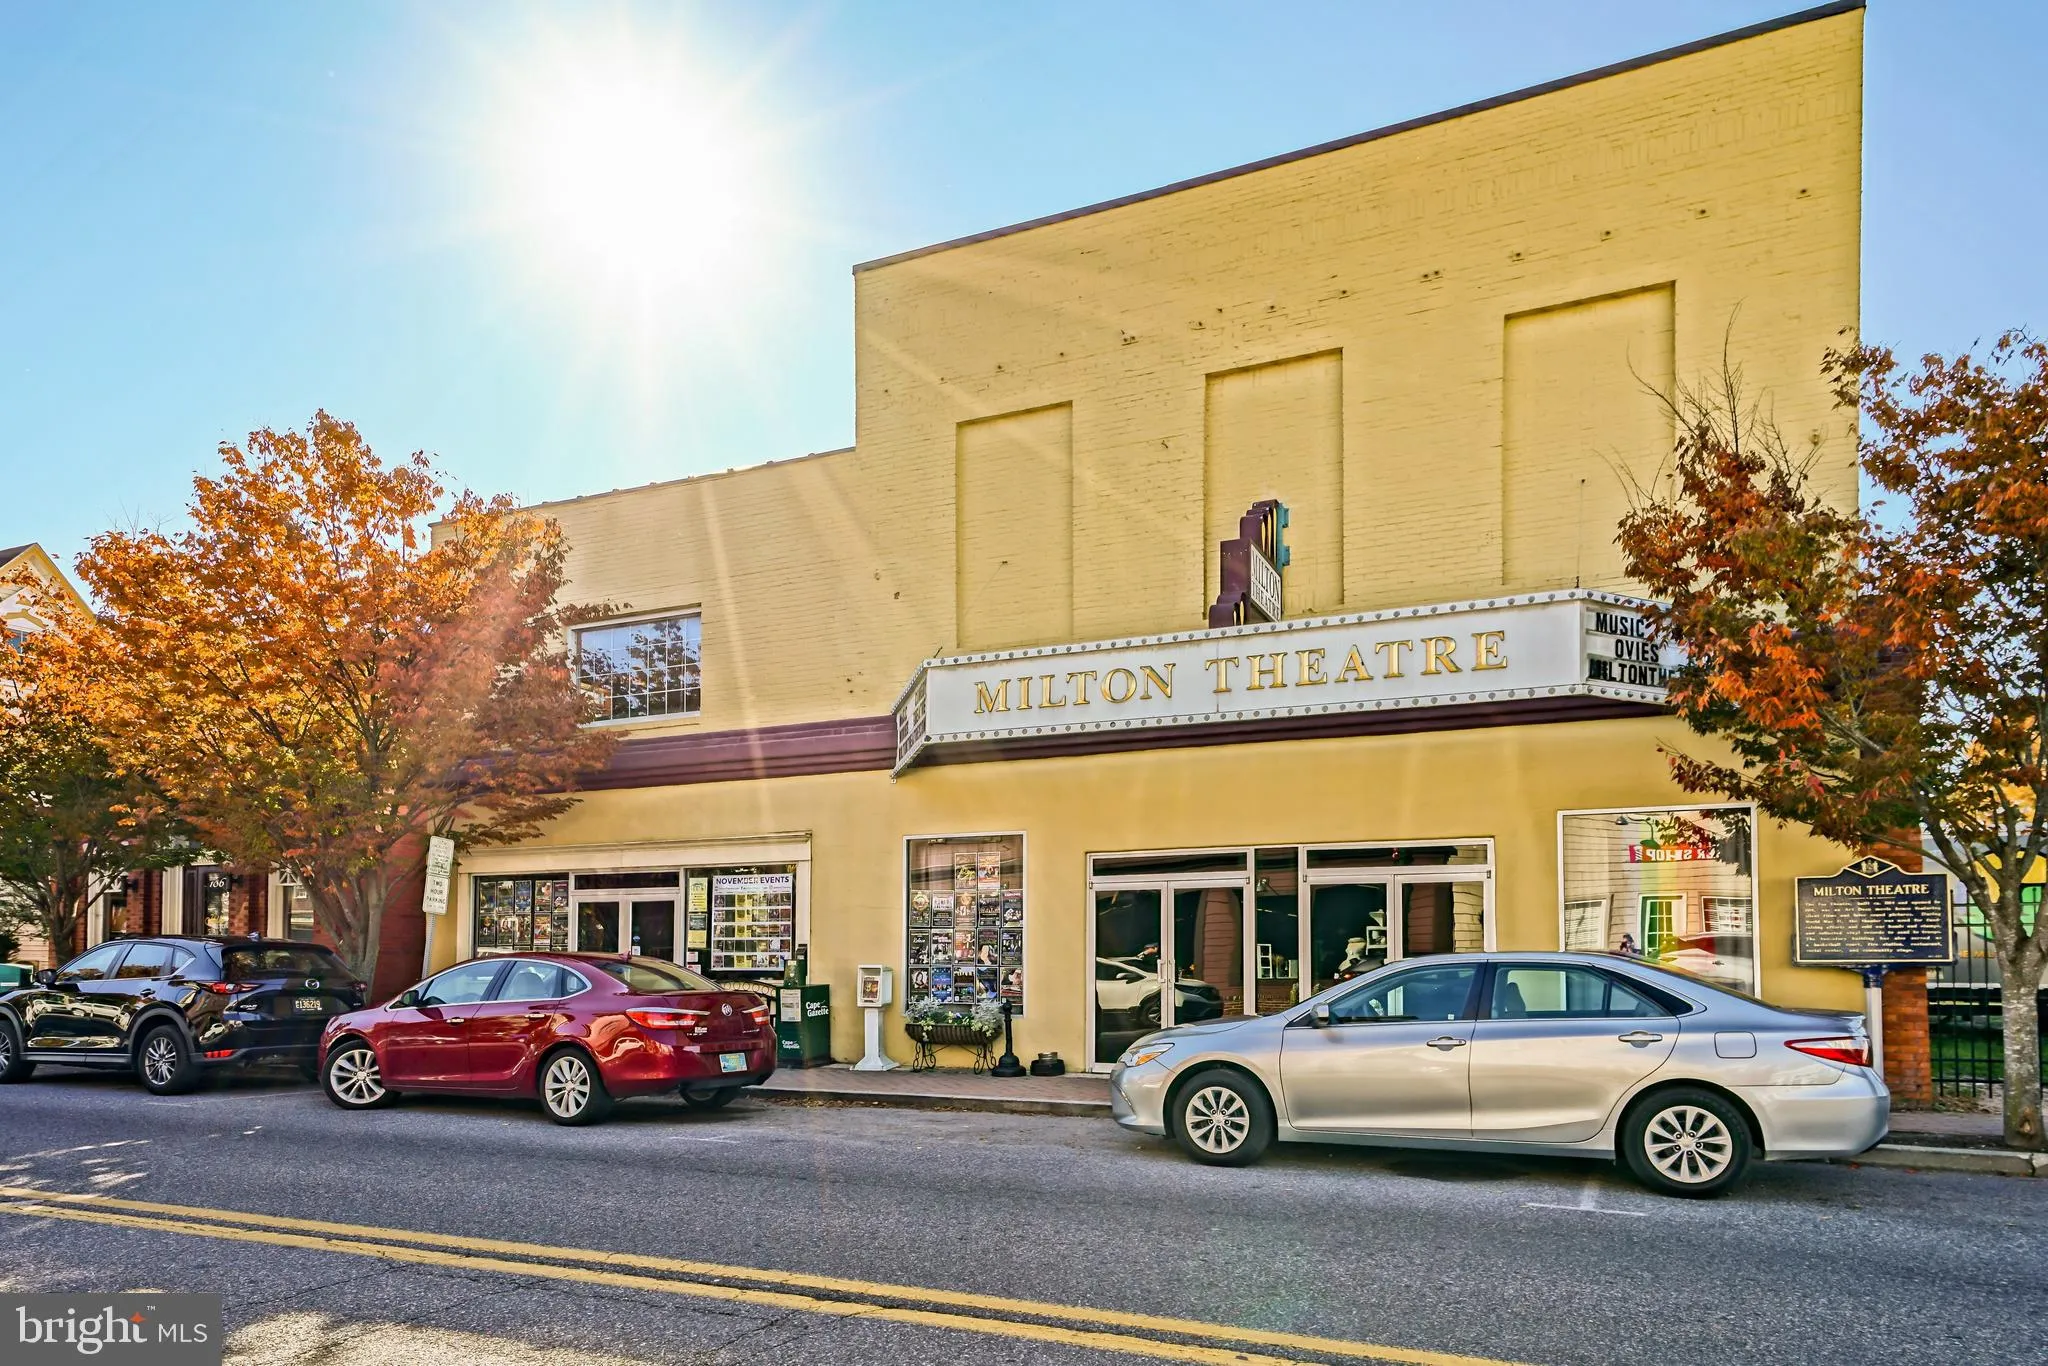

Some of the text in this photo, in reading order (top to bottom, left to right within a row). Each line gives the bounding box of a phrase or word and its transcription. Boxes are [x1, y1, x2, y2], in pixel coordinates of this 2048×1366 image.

[1596, 611, 1645, 638] MUSIC
[1615, 639, 1659, 662] OVIES
[974, 629, 1509, 715] MILTON THEATRE
[209, 877, 227, 888] 106
[760, 876, 789, 884] EVENTS
[1813, 883, 1930, 897] MILTON THEATRE
[805, 1001, 821, 1010] Cape
